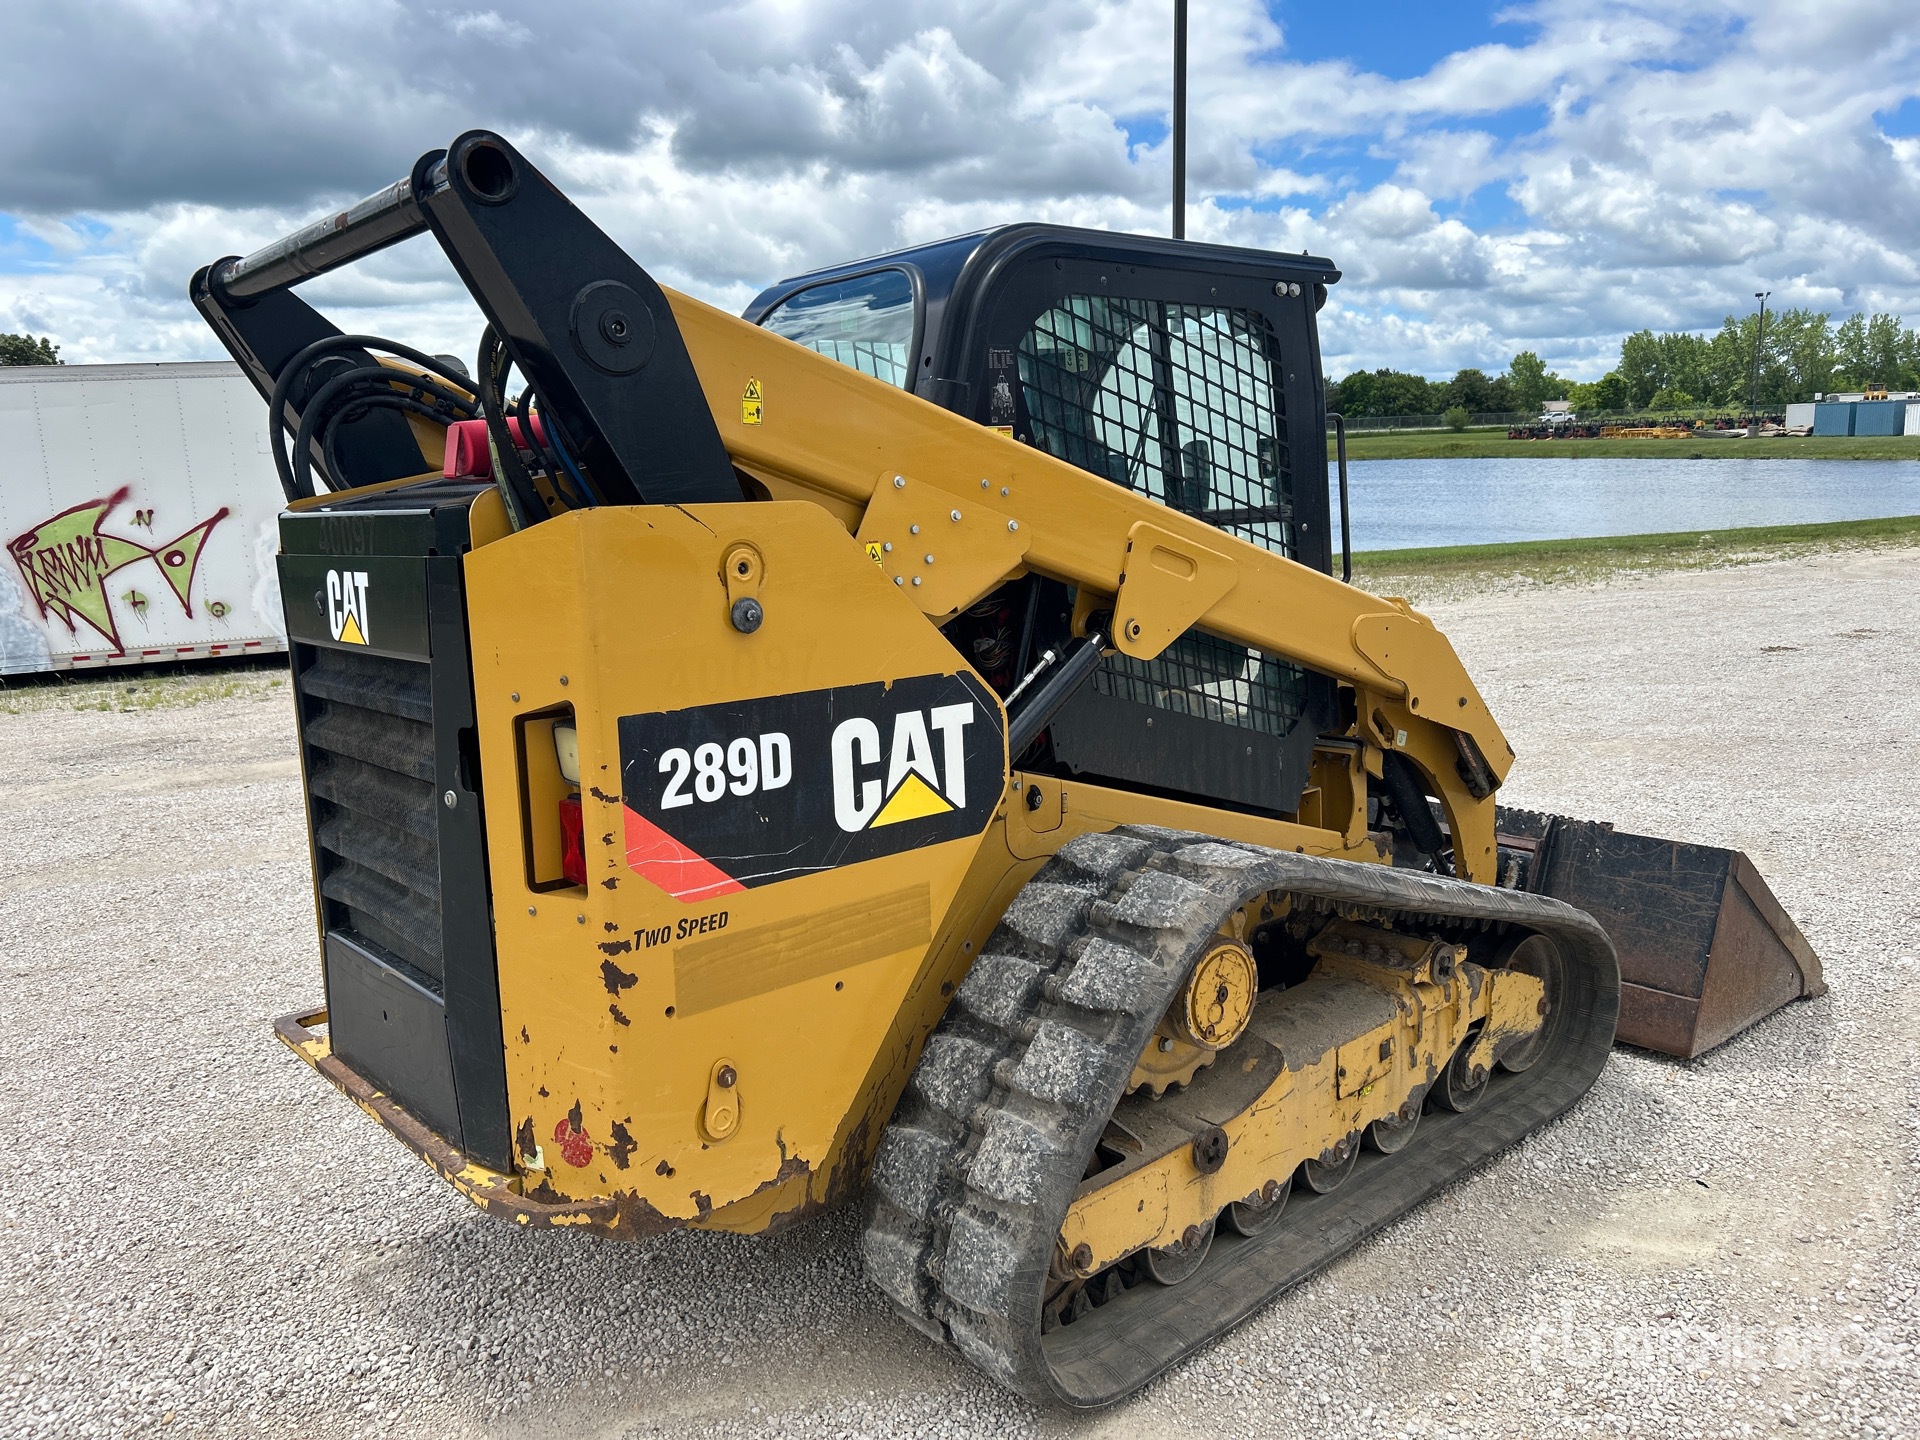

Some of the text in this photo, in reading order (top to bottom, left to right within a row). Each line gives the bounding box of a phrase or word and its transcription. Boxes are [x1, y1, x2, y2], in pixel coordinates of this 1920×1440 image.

[326, 569, 370, 646] CAT
[658, 702, 974, 832] 289D CAT
